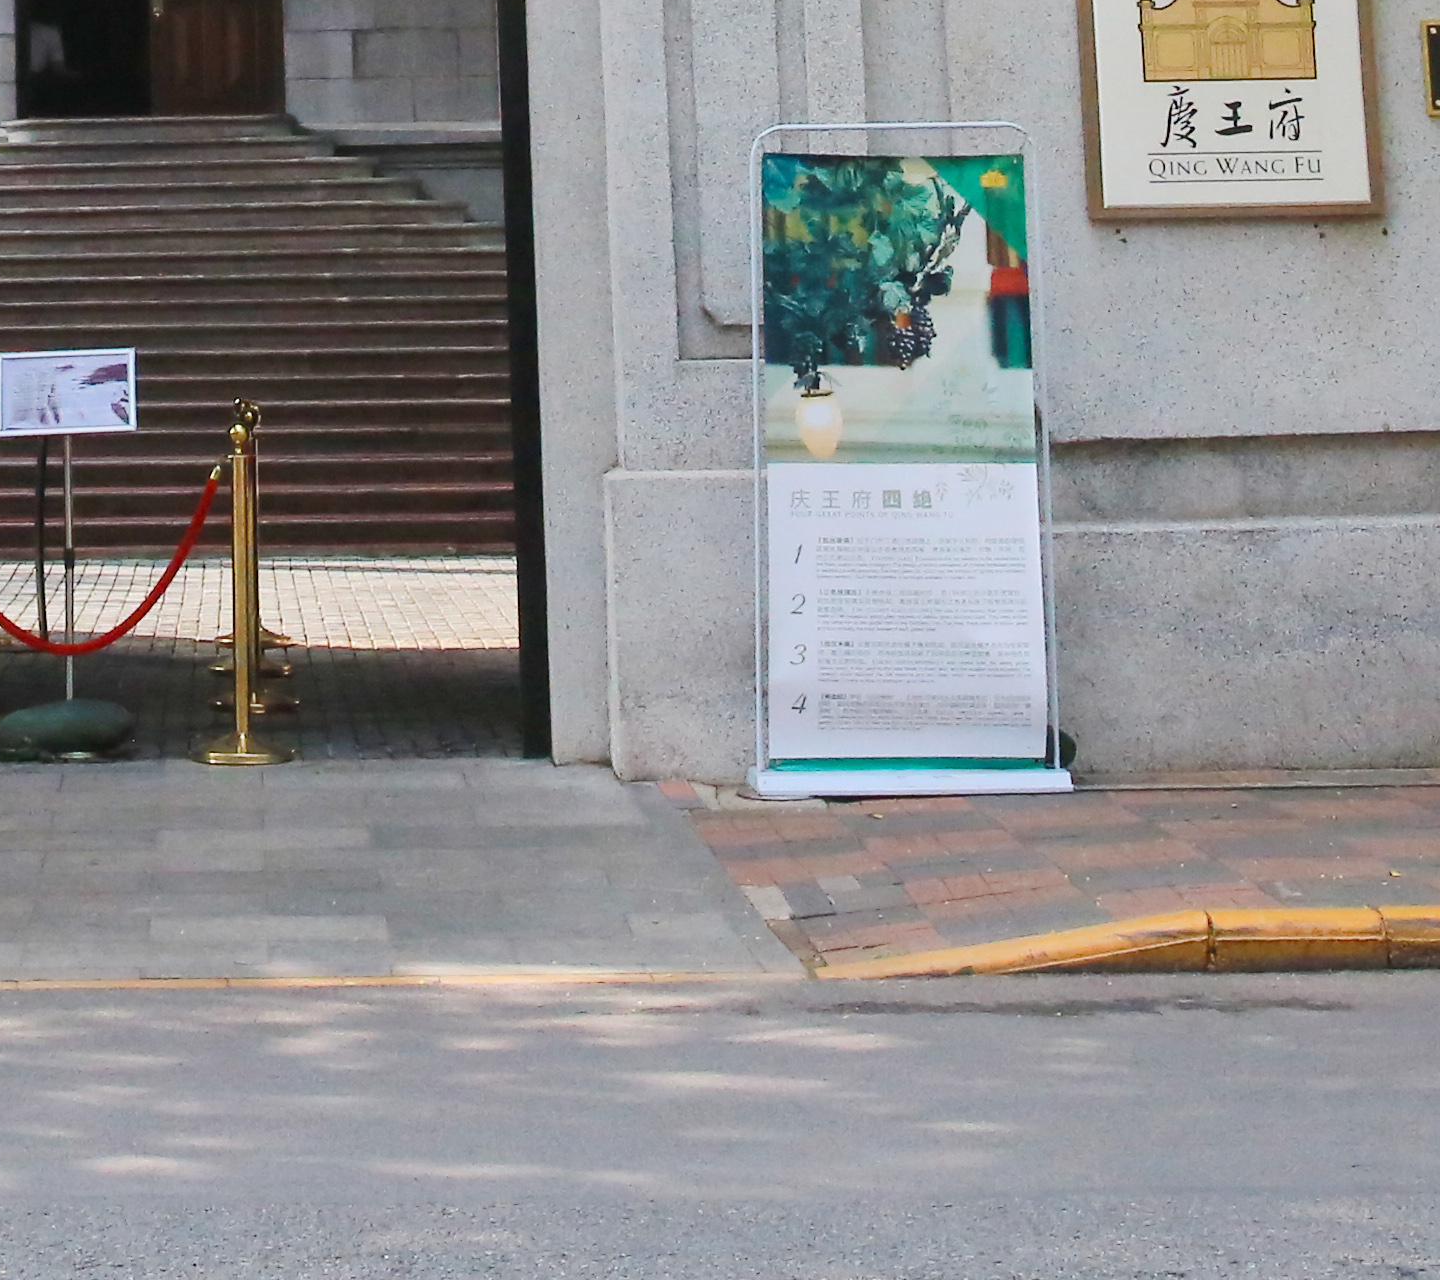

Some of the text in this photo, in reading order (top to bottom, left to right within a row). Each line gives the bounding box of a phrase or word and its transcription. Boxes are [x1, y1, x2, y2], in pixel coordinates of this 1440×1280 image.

[790, 489, 932, 509] 庆王府四绝
[794, 544, 803, 564] 1
[790, 593, 806, 614] 2
[789, 644, 807, 665] 3
[791, 692, 807, 714] 4
